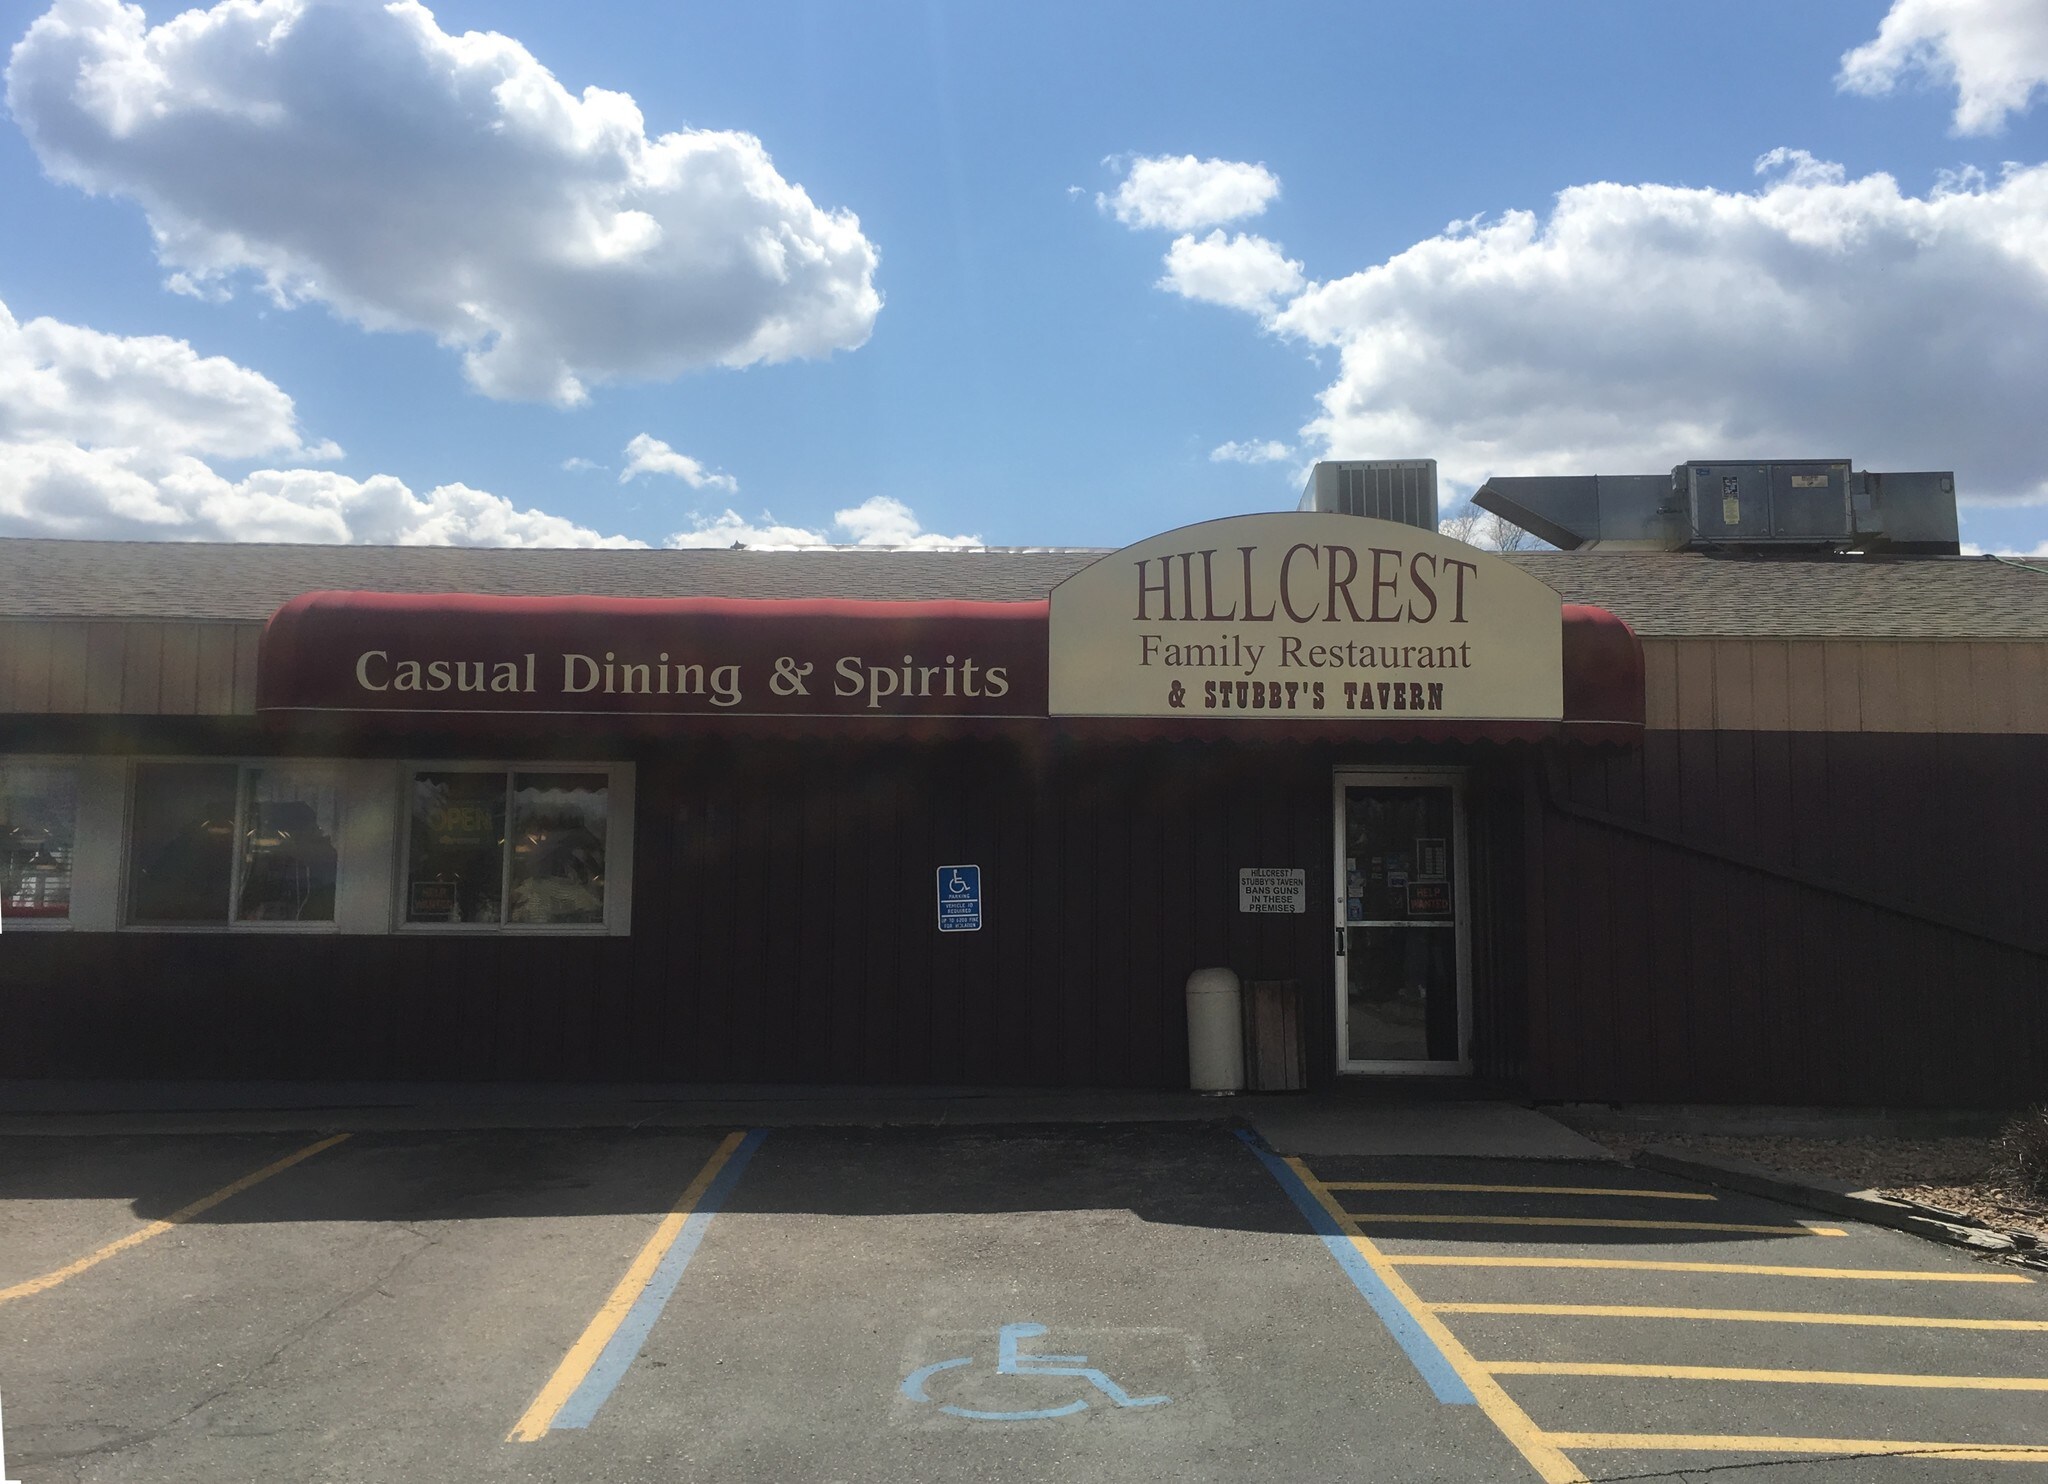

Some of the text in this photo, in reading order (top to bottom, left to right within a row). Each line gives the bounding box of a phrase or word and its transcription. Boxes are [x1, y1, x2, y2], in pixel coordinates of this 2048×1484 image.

[1132, 543, 1478, 624] HILLCREST
[1138, 634, 1472, 676] Family Restaurant
[355, 650, 1010, 708] Casual Dining & Spirits
[1167, 680, 1444, 711] & STUBBY'S TAVERN
[427, 807, 494, 832] OPEN
[1241, 878, 1303, 886] STUBBY'S TAVERN
[1246, 887, 1299, 895] BANS GUNS
[1416, 888, 1441, 897] HELP
[1251, 895, 1293, 903] IN THESE
[1410, 899, 1448, 909] WANTED
[1249, 904, 1296, 913] PREMISES
